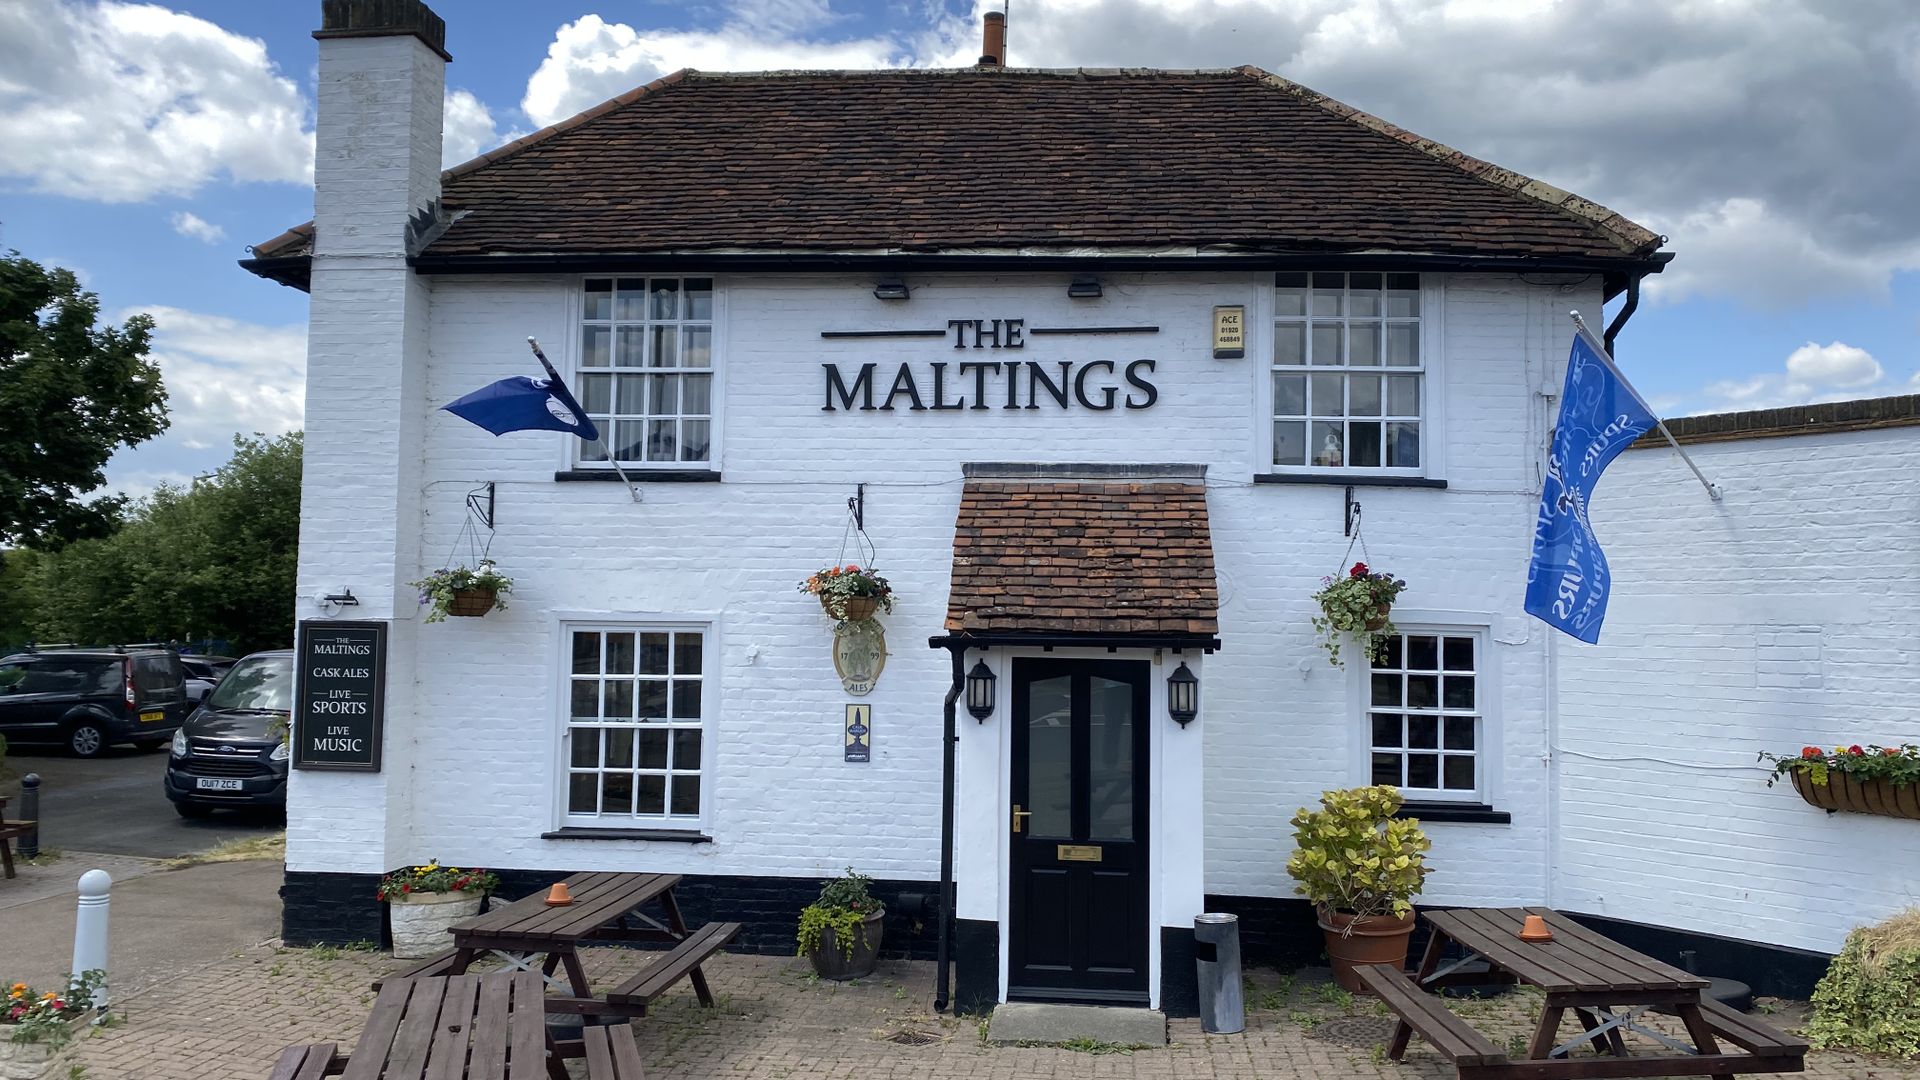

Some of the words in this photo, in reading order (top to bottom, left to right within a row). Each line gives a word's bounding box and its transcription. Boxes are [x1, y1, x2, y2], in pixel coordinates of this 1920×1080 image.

[948, 318, 1025, 349] THE
[821, 359, 1158, 411] MALTINGS
[314, 644, 370, 655] MALTINGS
[840, 652, 849, 661] 17
[870, 652, 880, 661] 99
[312, 667, 341, 678] CASK
[342, 667, 369, 678] ALES
[848, 683, 869, 693] ALES
[329, 689, 351, 699] LIVE
[312, 701, 367, 715] SPORTS
[327, 726, 350, 735] LIVE
[313, 738, 362, 752] MUSIC
[220, 780, 237, 789] ZCE
